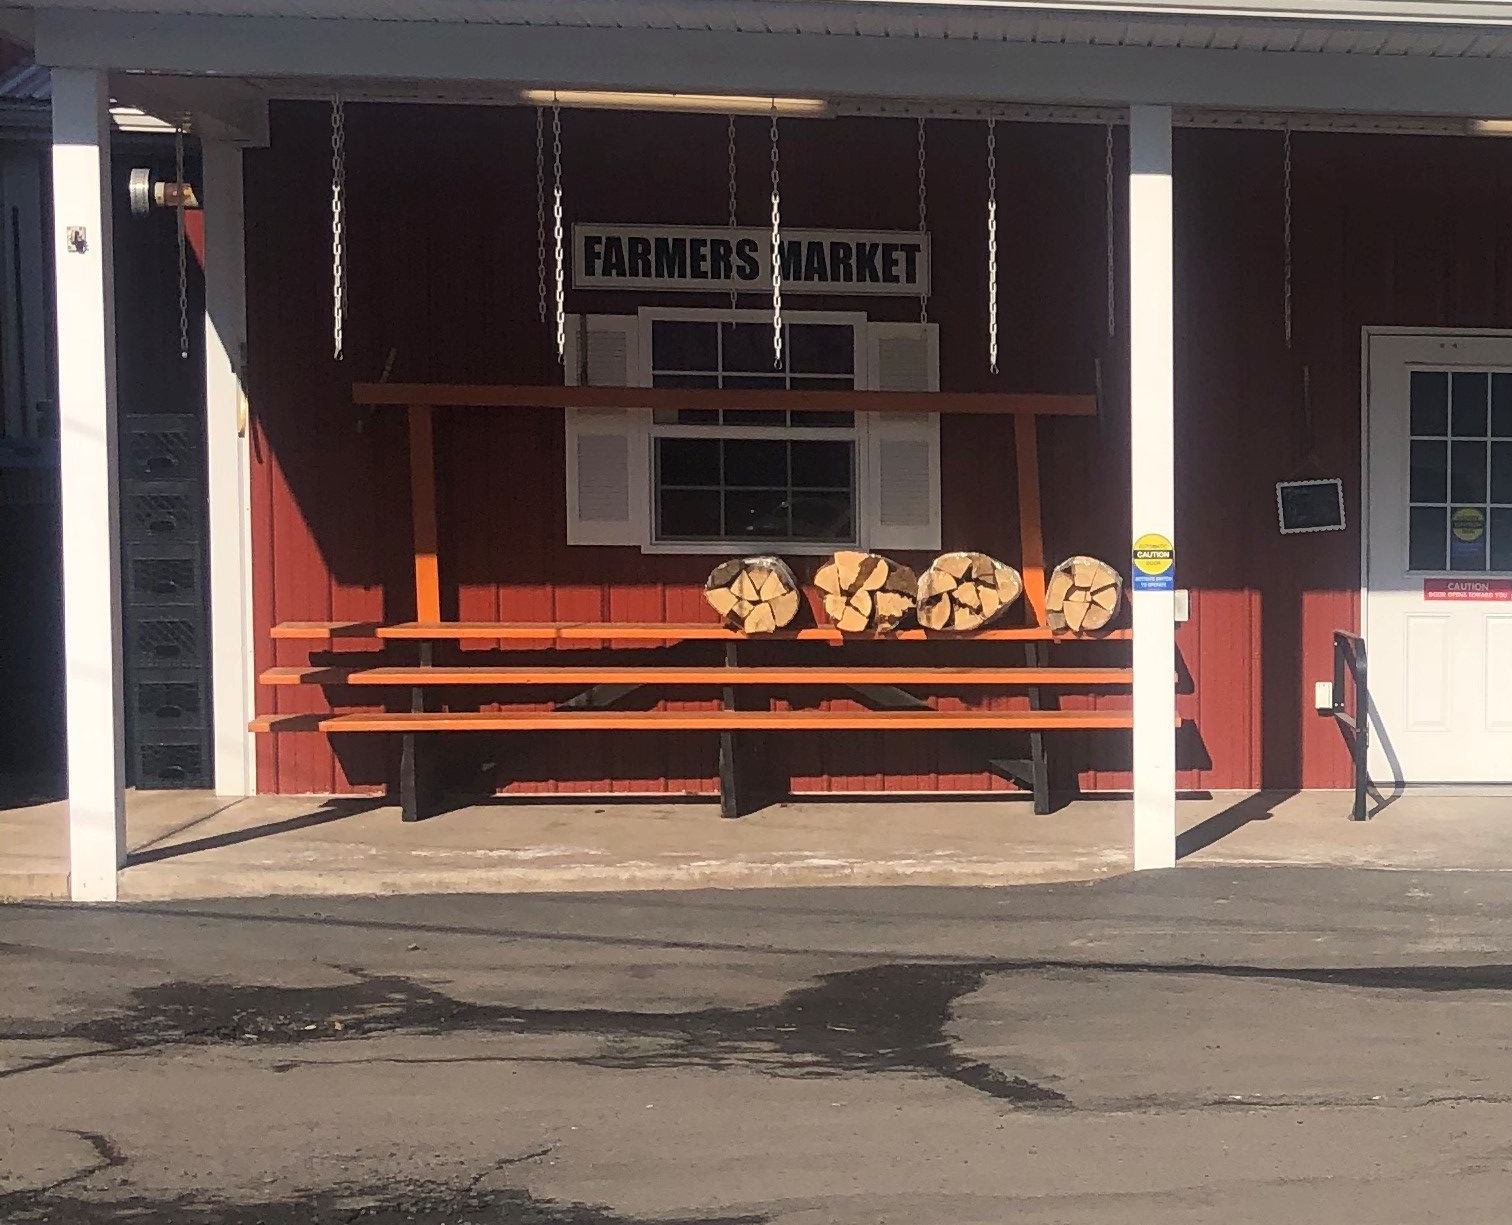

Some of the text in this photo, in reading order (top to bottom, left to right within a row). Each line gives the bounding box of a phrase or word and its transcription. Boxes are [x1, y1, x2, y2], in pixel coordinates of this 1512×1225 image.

[583, 235, 922, 284] FARMERS MARKET
[1136, 551, 1170, 559] CAUTION
[1447, 582, 1489, 591] CAUTION
